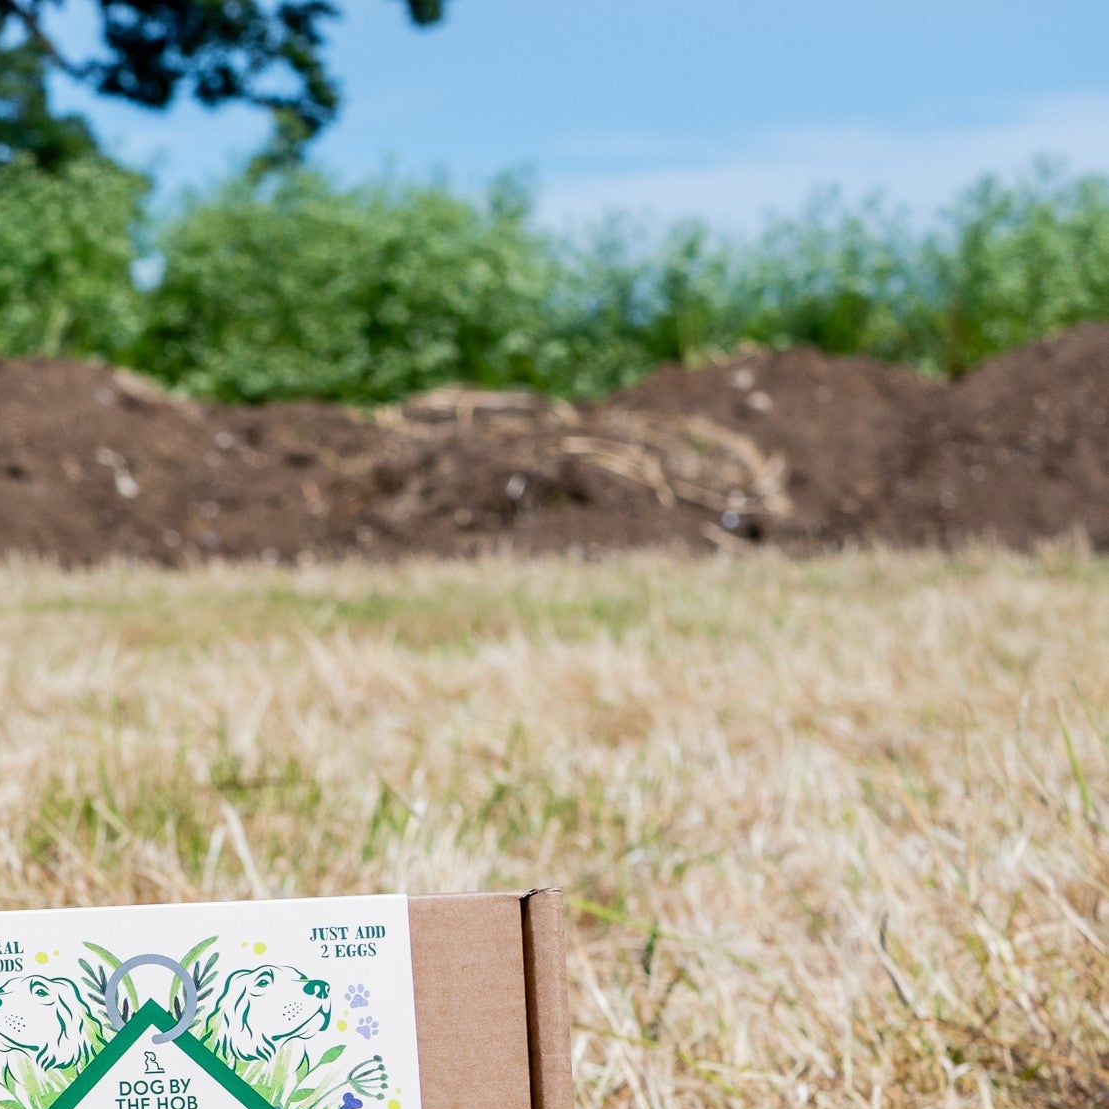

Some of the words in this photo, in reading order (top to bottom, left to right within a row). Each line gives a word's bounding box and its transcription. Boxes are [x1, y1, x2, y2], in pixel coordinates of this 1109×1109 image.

[309, 926, 349, 941] JUST
[355, 924, 386, 940] ADD
[321, 944, 329, 958] 2
[335, 942, 377, 958] EGGS
[119, 1079, 166, 1097] DOG
[169, 1078, 192, 1095] BY
